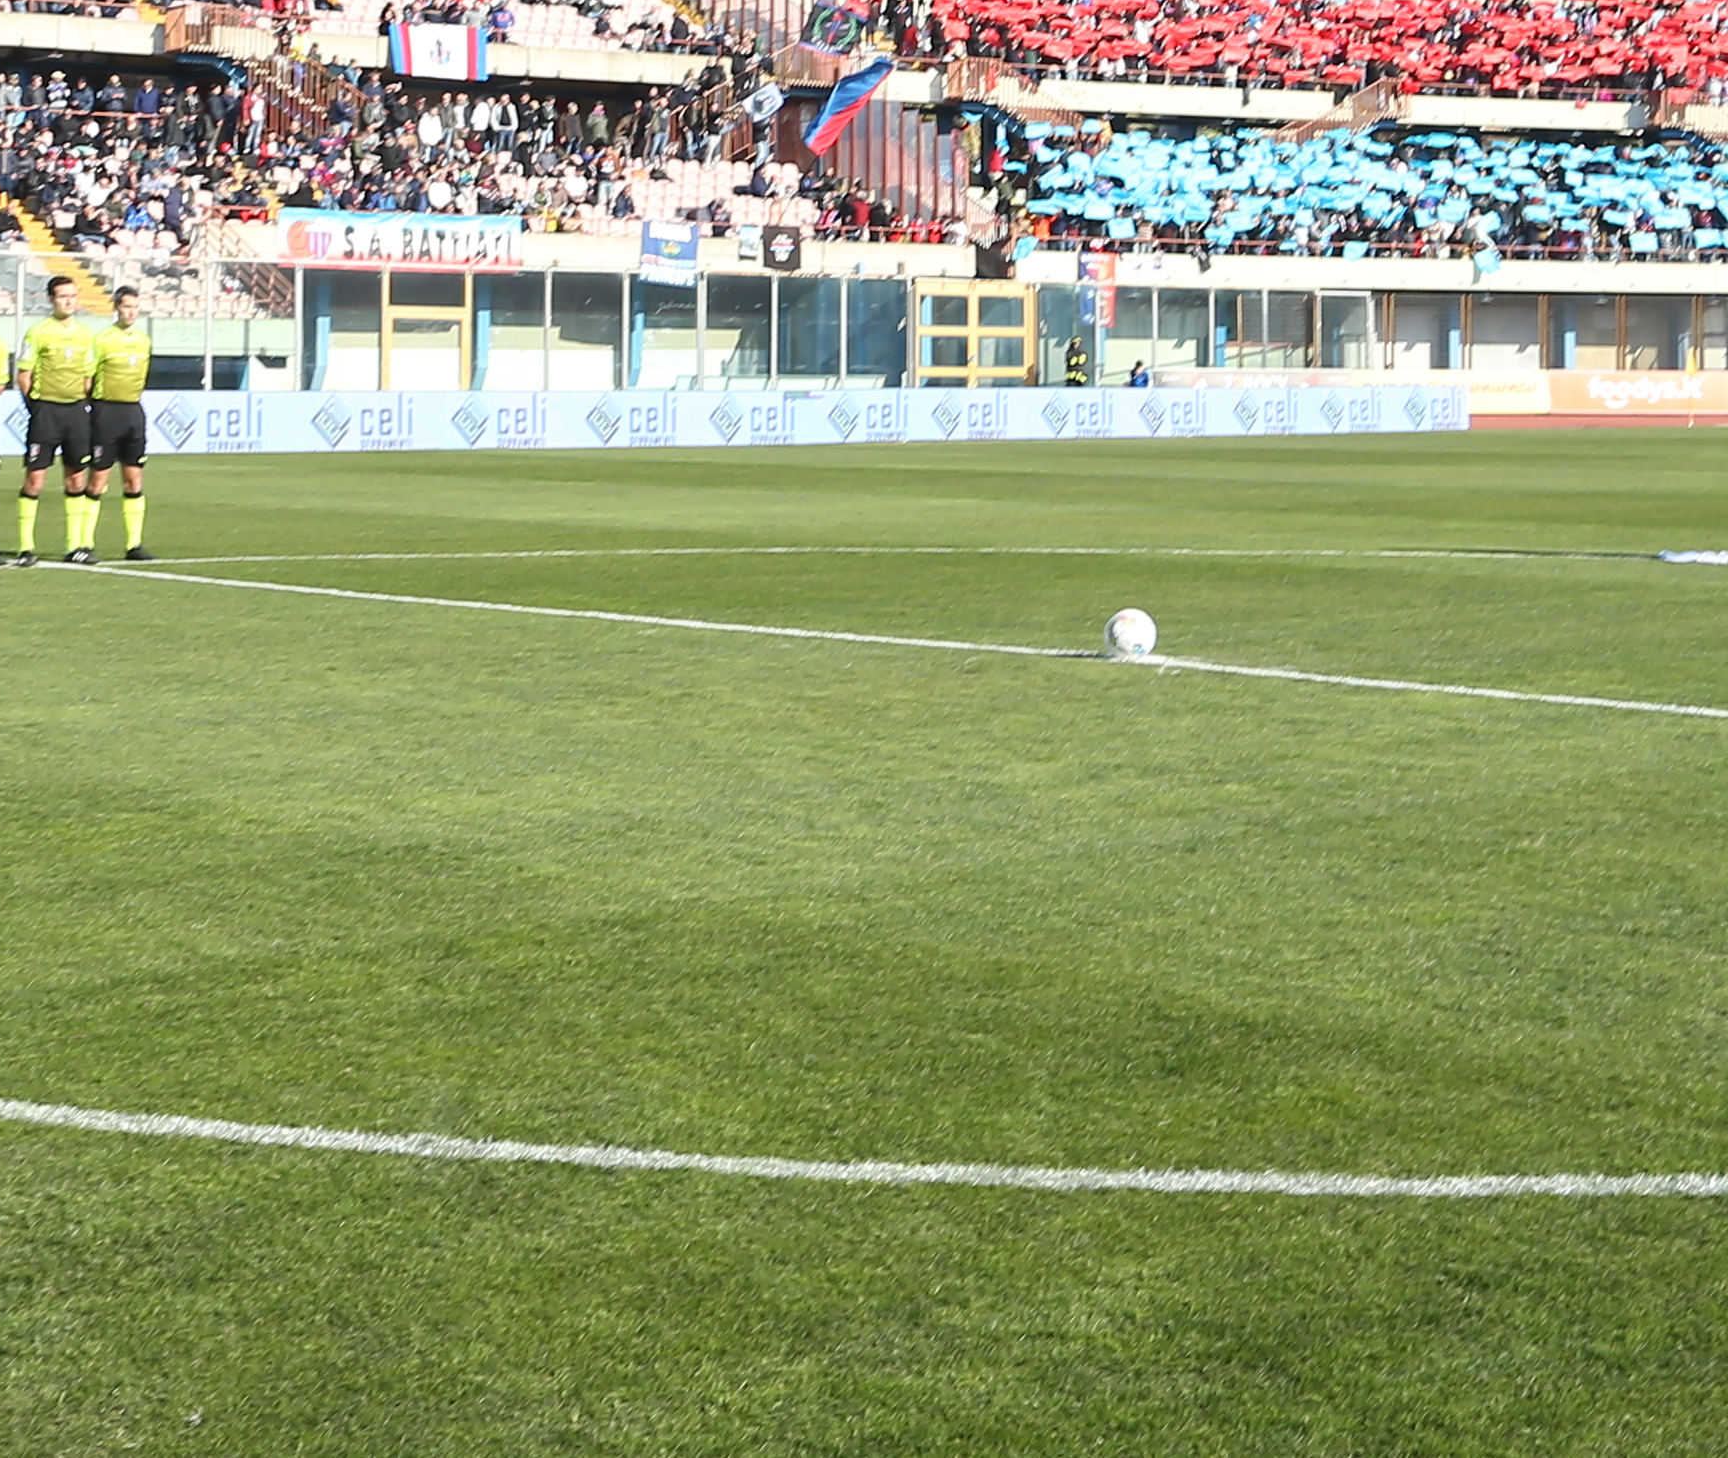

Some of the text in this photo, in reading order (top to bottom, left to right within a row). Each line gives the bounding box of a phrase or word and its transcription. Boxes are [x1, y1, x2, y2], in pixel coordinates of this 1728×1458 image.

[206, 392, 263, 438] celi
[361, 392, 413, 437] celi
[497, 392, 546, 435] celi
[629, 392, 677, 434] celi
[866, 390, 909, 431] celi
[967, 390, 1008, 428] celi
[1075, 389, 1114, 427] celi
[1171, 389, 1207, 426] celi
[1263, 388, 1298, 423] celi
[1349, 387, 1382, 422] celi
[1430, 387, 1462, 421] celi
